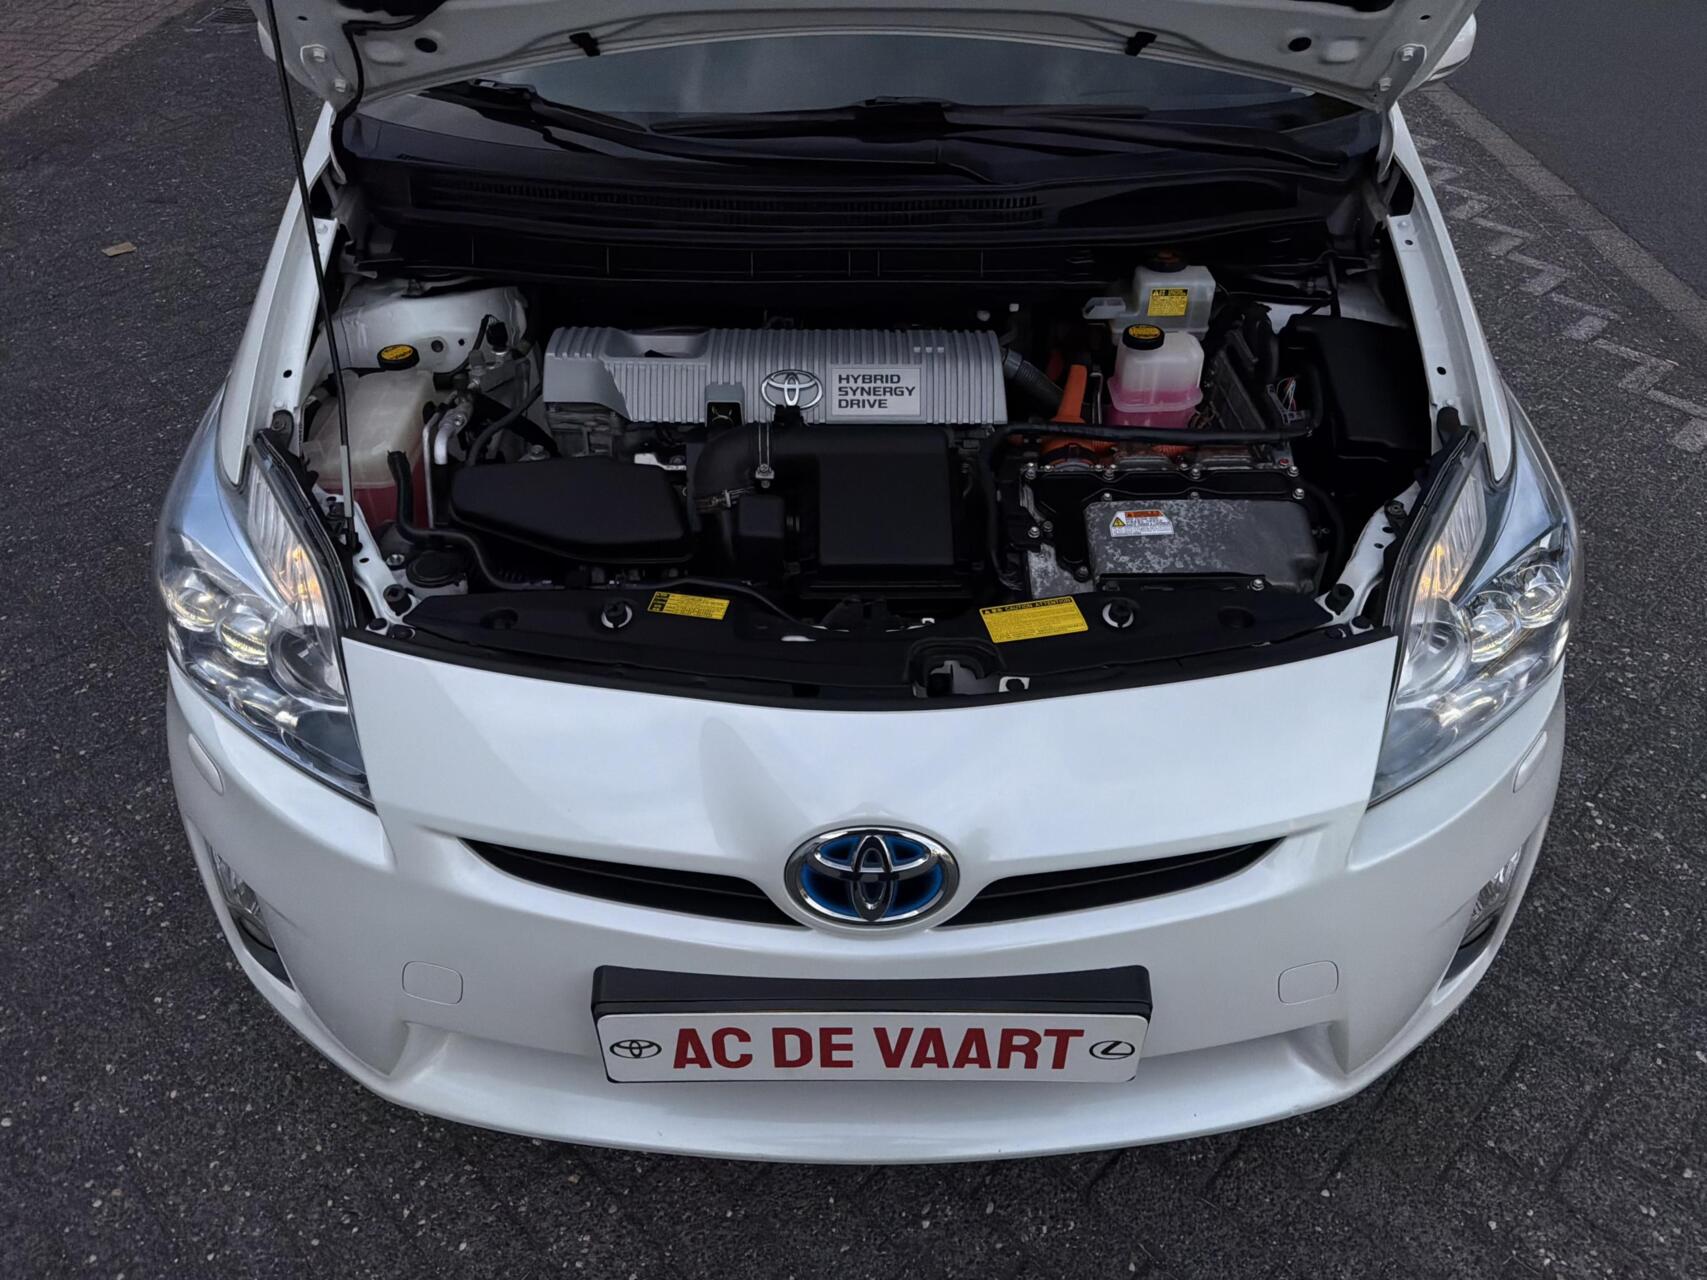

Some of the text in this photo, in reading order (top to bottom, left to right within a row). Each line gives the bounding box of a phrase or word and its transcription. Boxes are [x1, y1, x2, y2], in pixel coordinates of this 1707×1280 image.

[838, 374, 901, 384] HYBRID
[838, 386, 916, 396] SYNERGY
[838, 399, 888, 409] DRIVE
[672, 1027, 1085, 1069] AC DE VAART
